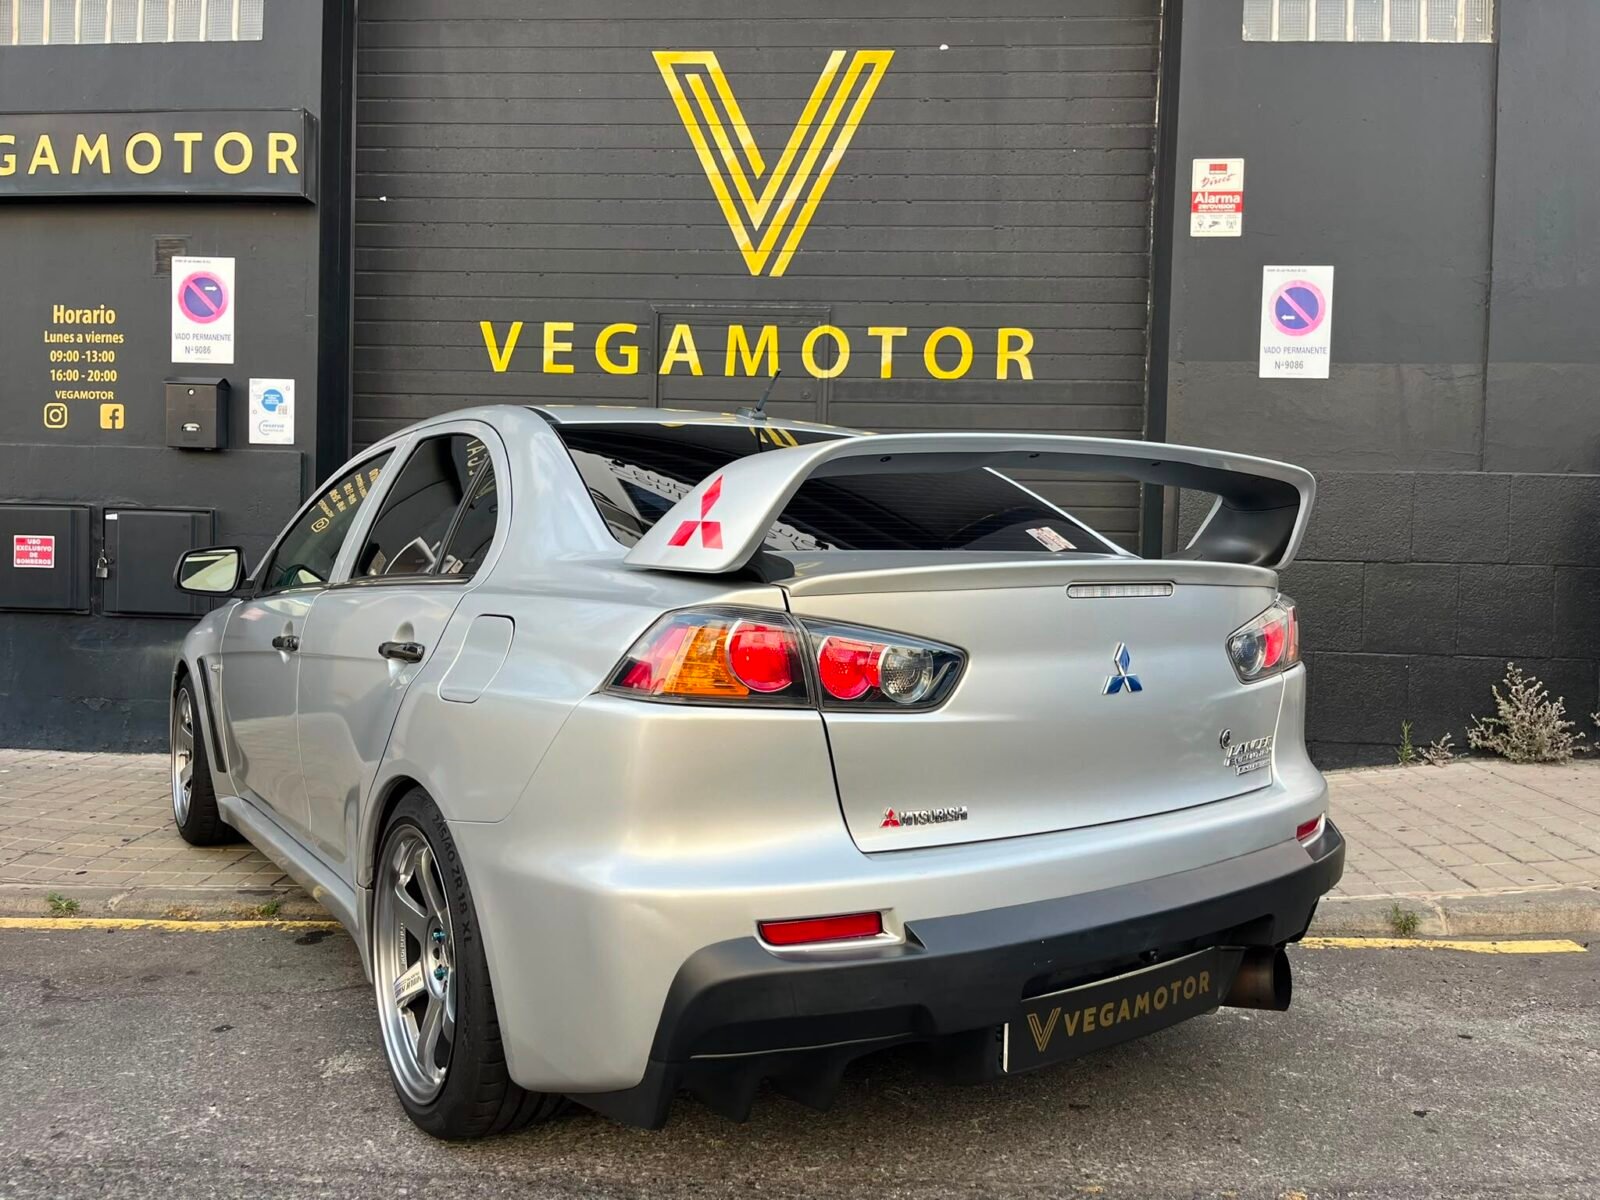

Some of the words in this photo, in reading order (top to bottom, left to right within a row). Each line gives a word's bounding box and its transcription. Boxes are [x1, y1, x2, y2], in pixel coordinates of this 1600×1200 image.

[1194, 192, 1241, 204] Alarma
[53, 304, 116, 324] Horario
[44, 330, 75, 343] Lunes
[76, 333, 83, 343] a
[85, 331, 124, 344] viernes
[175, 332, 191, 341] VADO
[192, 333, 232, 342] PERMANENTE
[50, 350, 79, 362] 09:00
[479, 320, 1034, 381] VEGAMOTOR
[1264, 346, 1281, 354] VADO
[1283, 346, 1328, 355] PERMANENTE
[50, 369, 79, 381] 16:00
[87, 370, 117, 382] 20:00
[55, 390, 114, 400] VEGAMOTOR
[462, 920, 473, 947] XL
[1064, 970, 1211, 1037] VEGAMOTOR
